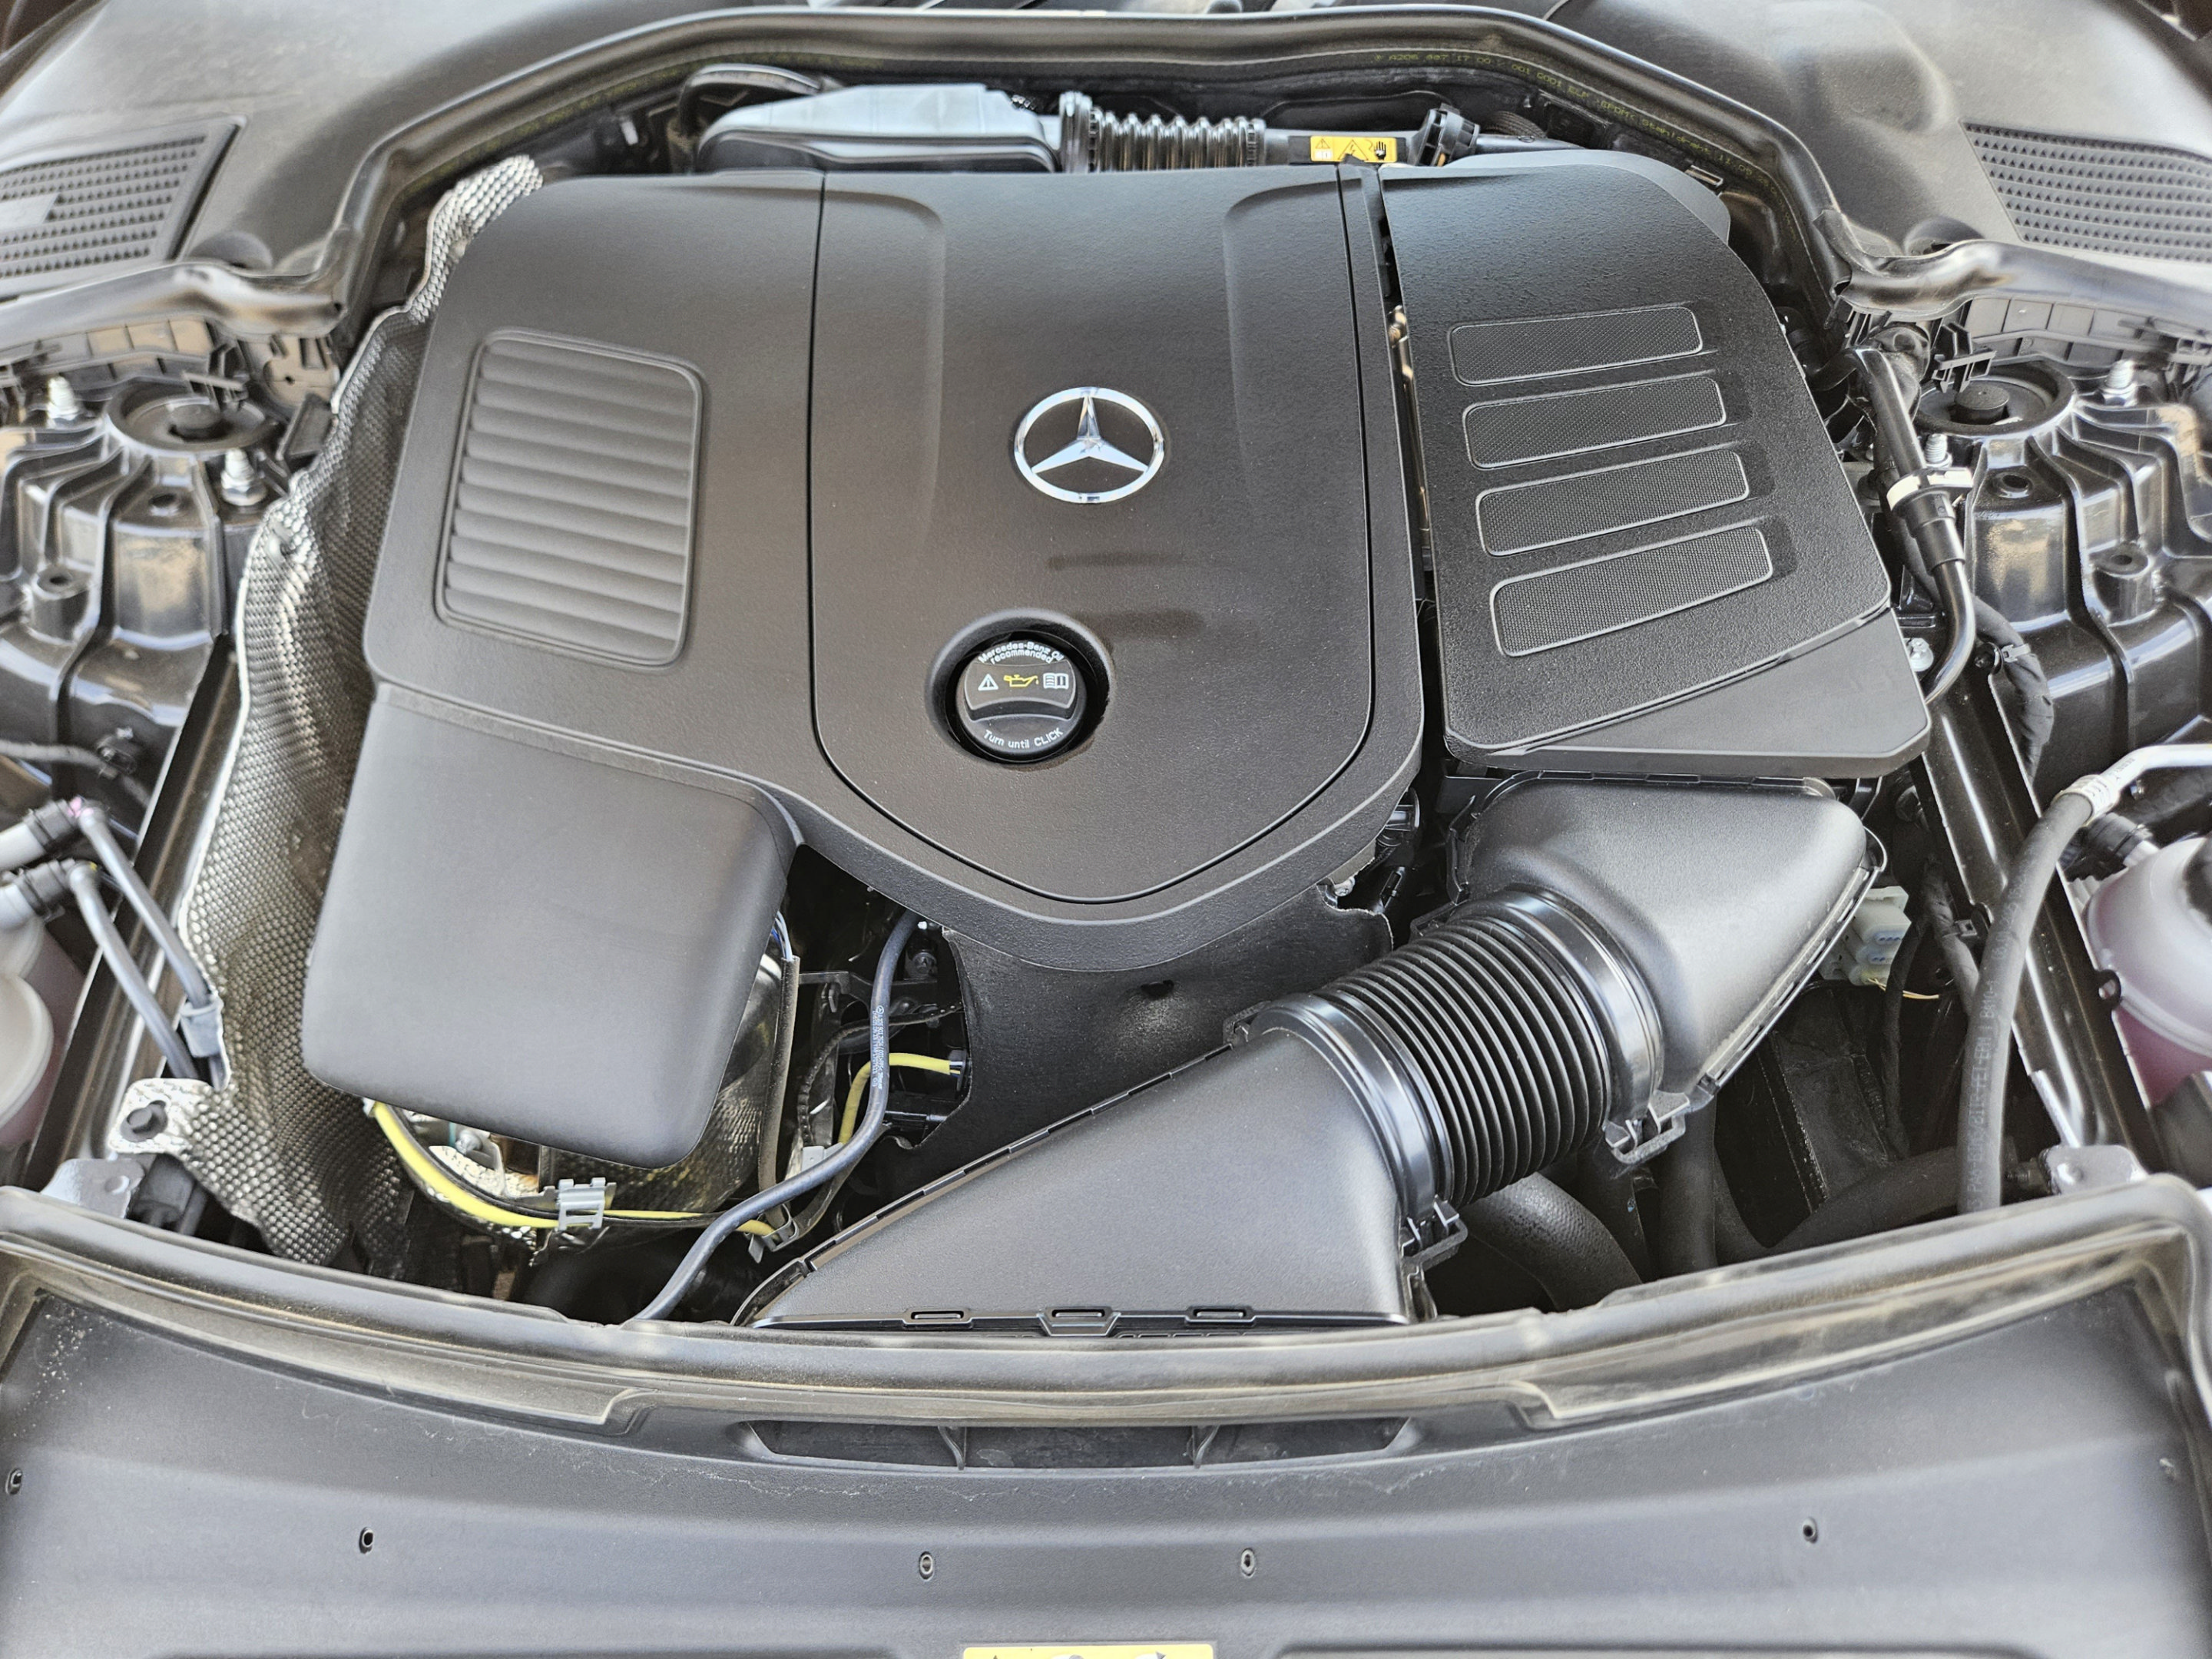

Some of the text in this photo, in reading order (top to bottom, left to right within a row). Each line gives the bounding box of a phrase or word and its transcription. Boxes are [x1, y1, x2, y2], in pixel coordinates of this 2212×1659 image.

[978, 641, 1065, 663] Mercedes-Benz Oil
[990, 649, 1052, 665] recommended
[984, 727, 1064, 749] Turn until CLICK
